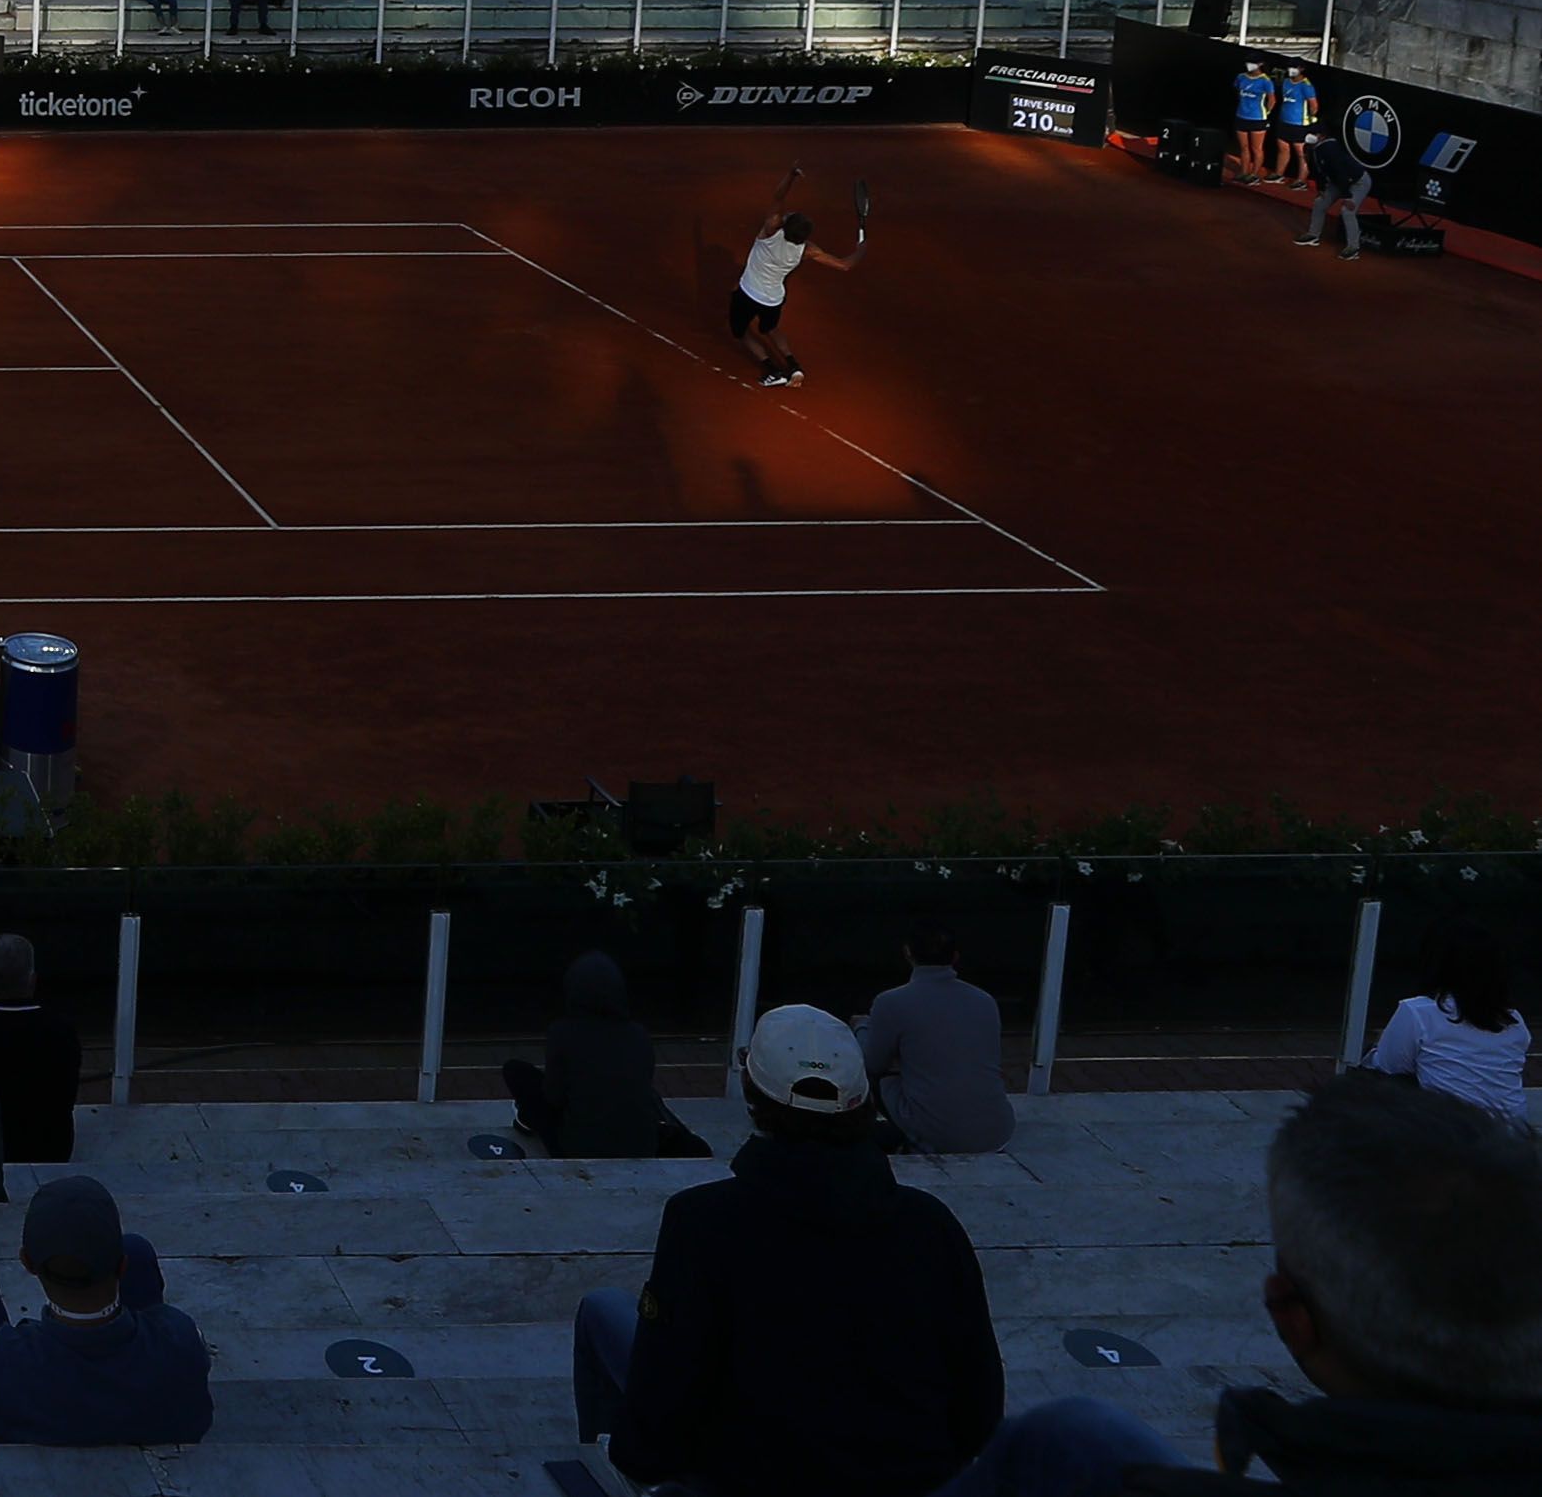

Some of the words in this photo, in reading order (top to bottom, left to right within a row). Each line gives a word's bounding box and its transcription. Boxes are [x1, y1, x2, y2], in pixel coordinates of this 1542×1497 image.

[988, 65, 1096, 87] FRECCIAROSSA
[19, 91, 133, 116] ticketone
[470, 87, 582, 109] RICOH
[708, 86, 873, 104] DUNLOP
[1013, 97, 1043, 110] SERVE
[1043, 101, 1076, 114] SPEED
[1352, 99, 1395, 124] BMW
[1013, 109, 1054, 132] 210
[1162, 128, 1170, 139] 2
[1194, 136, 1200, 147] 1
[488, 1143, 503, 1156] 4
[288, 1180, 305, 1193] 4
[1095, 1345, 1121, 1364] 4
[356, 1355, 385, 1375] 2
